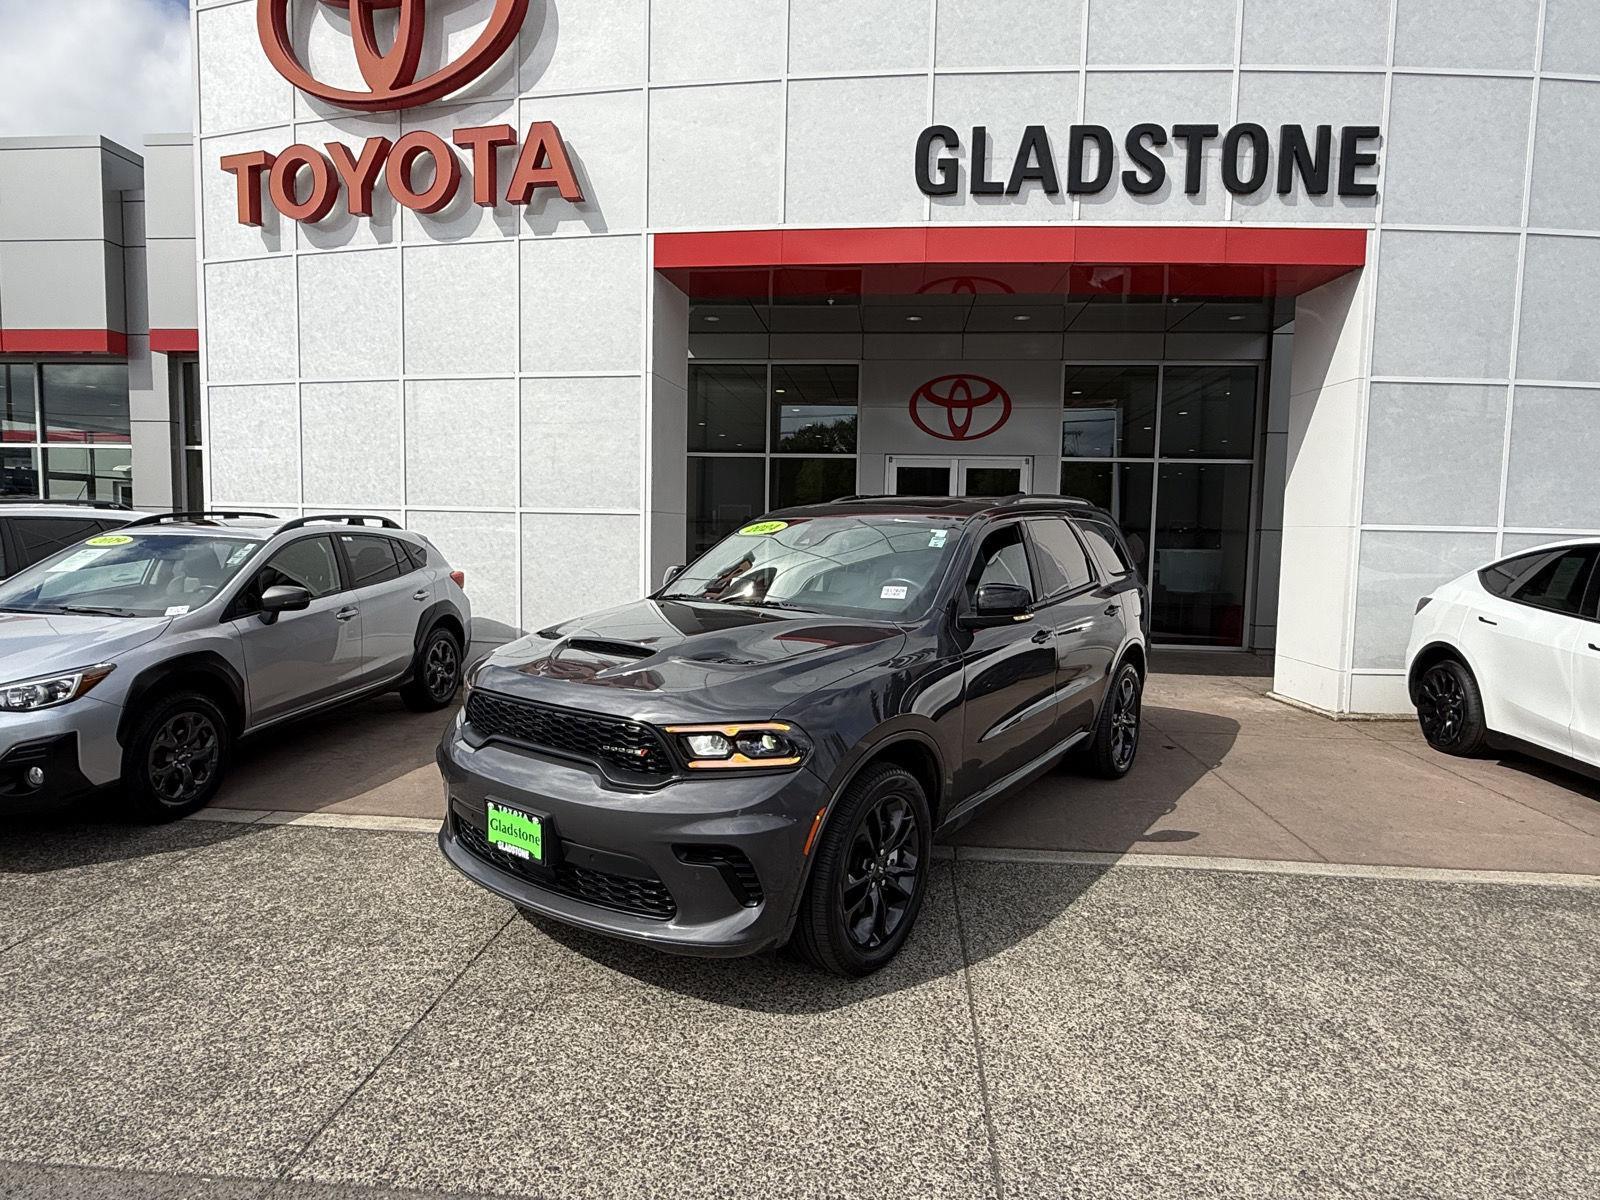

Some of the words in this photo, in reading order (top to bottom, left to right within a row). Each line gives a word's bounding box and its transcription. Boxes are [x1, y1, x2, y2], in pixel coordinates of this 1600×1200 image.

[915, 123, 1379, 196] GLADSTONE
[220, 121, 585, 227] TOYOTA
[602, 745, 641, 756] DODGE
[498, 804, 528, 820] TOYOTA
[489, 818, 541, 846] Gladstone
[497, 840, 530, 860] GLADSTONE
